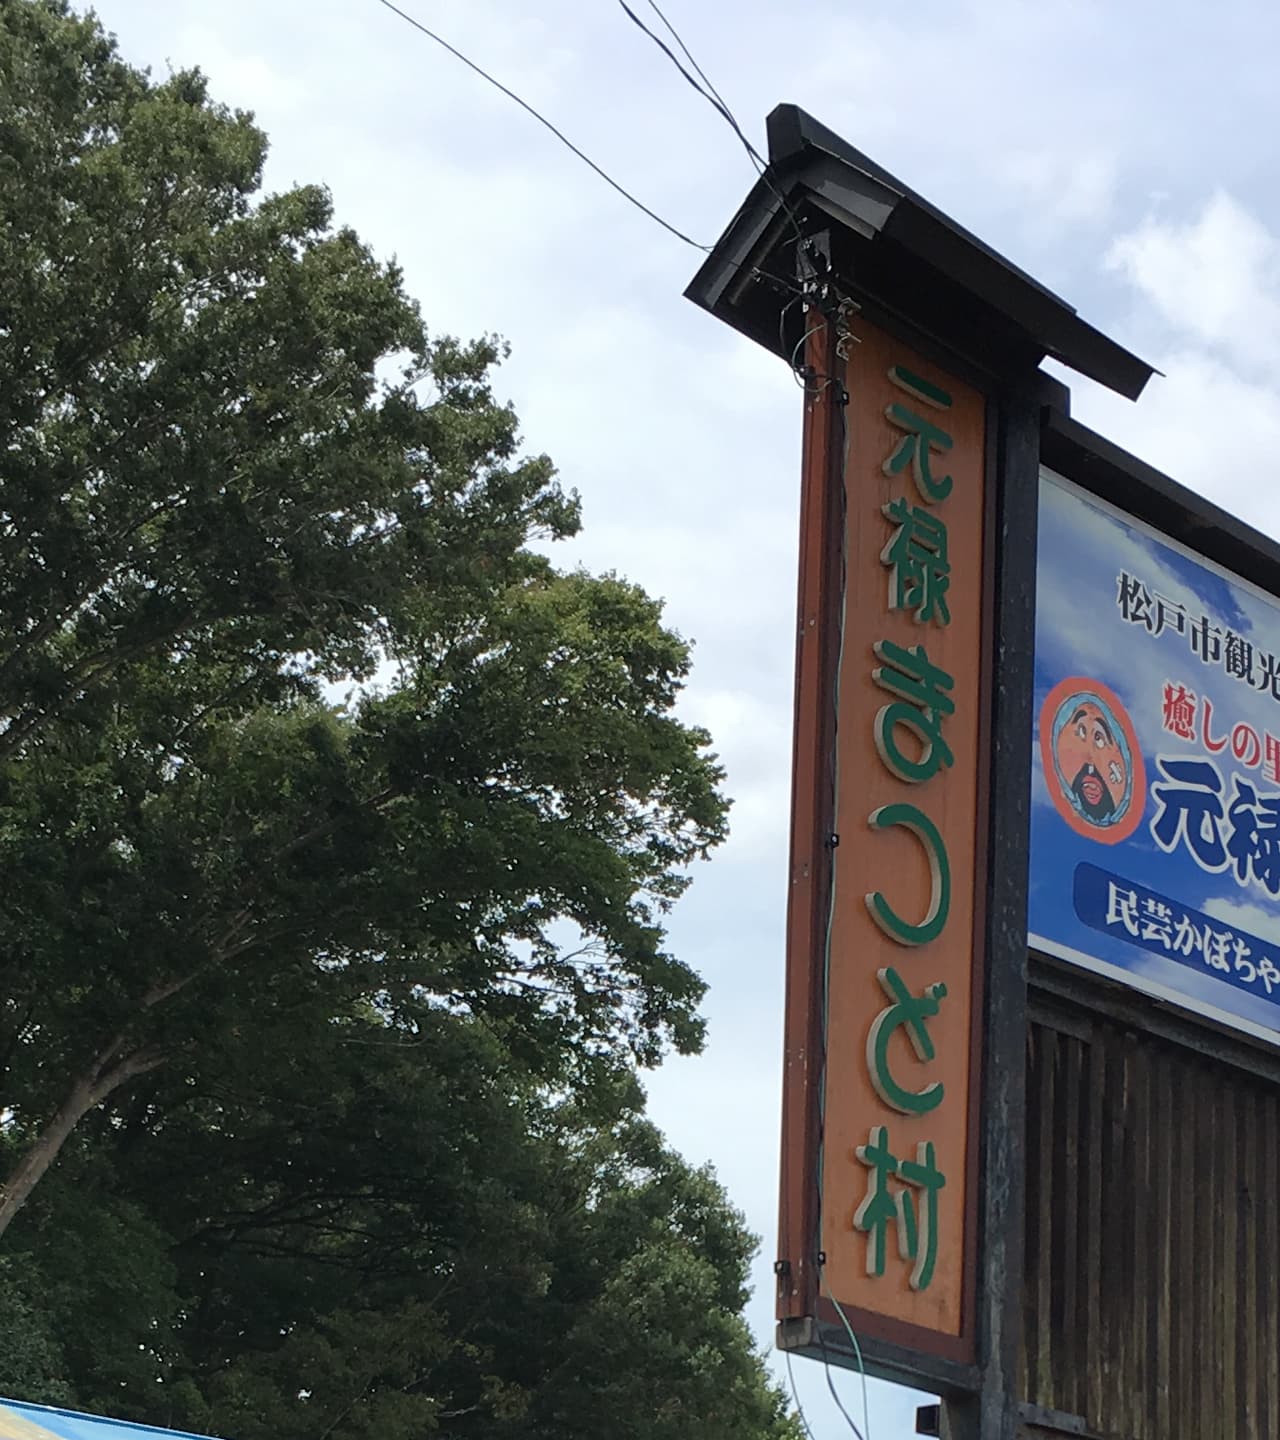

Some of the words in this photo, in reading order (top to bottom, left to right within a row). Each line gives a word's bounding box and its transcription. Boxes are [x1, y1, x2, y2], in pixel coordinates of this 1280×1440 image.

[856, 364, 955, 1292] 元禄まつど村
